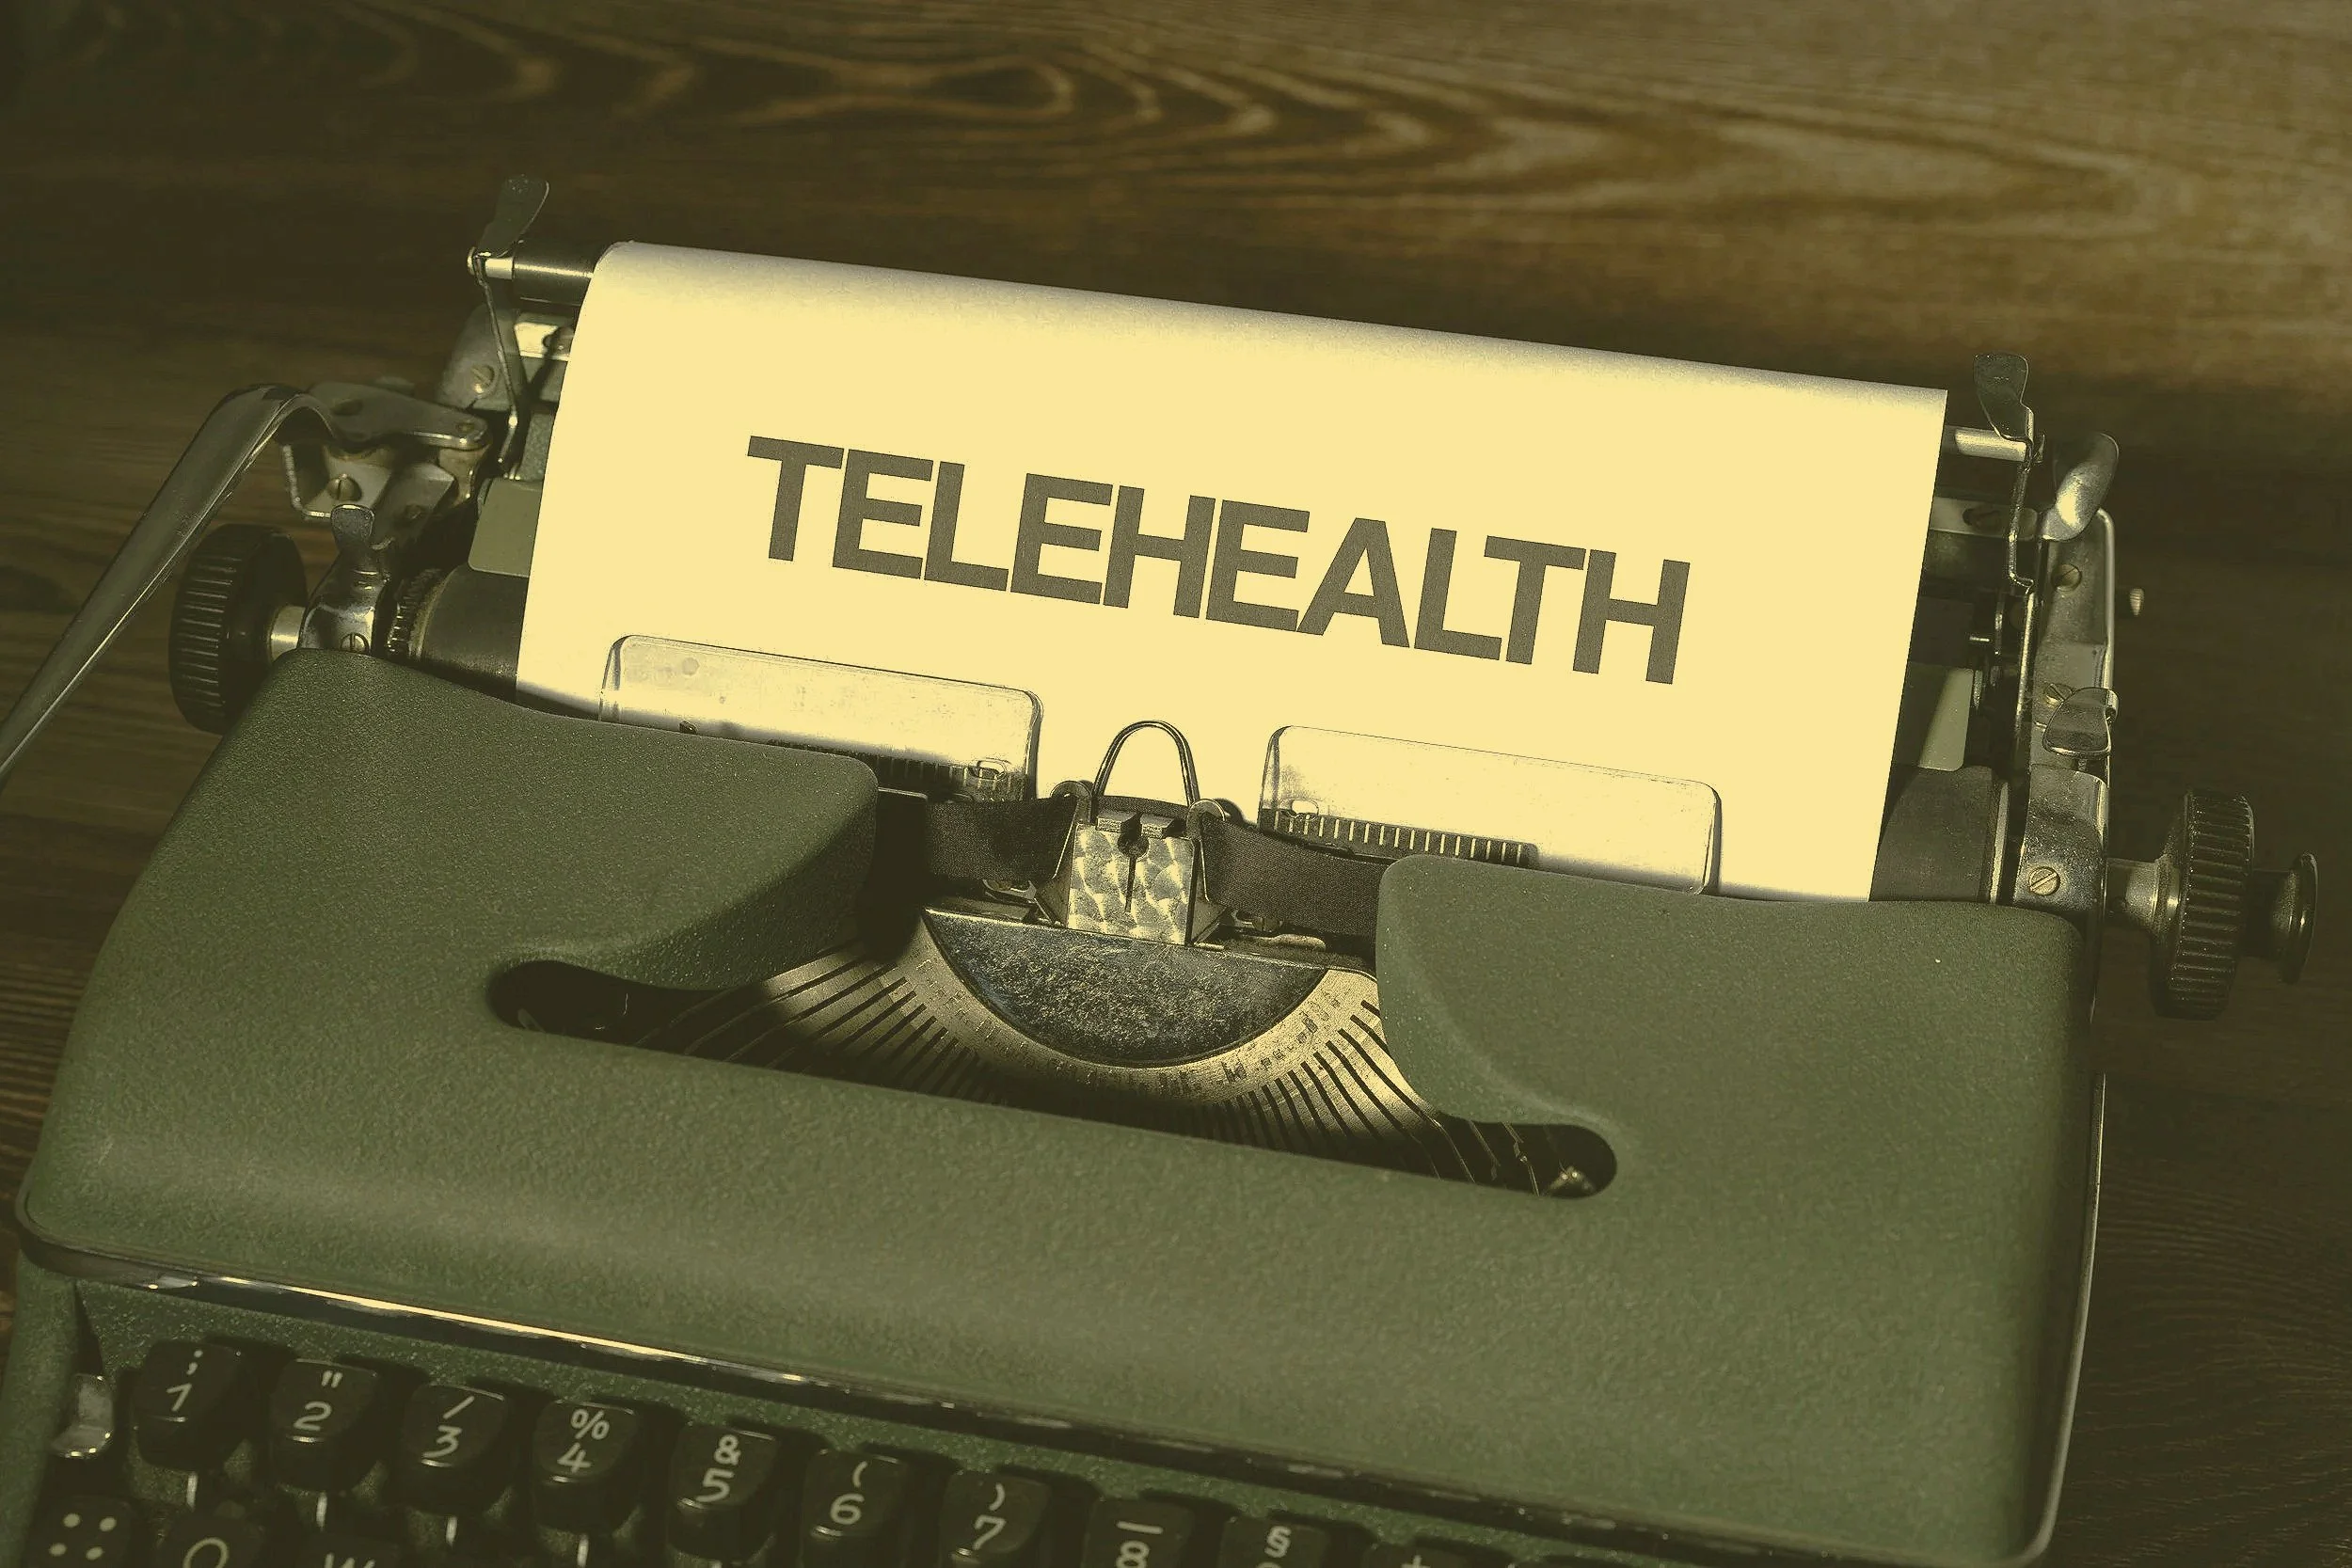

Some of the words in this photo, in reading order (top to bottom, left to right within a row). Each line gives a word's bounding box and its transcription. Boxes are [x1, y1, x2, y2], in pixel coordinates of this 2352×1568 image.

[747, 436, 1691, 685] TELEHEALTH
[167, 1383, 193, 1412] 1
[293, 1401, 332, 1432] 2
[570, 1408, 611, 1441] %
[422, 1425, 462, 1460] 3
[556, 1442, 592, 1474] 4
[713, 1433, 741, 1466] &
[695, 1468, 735, 1504] 5
[830, 1493, 865, 1525] 6
[972, 1514, 1007, 1552] 7
[1116, 1541, 1150, 1568] 8
